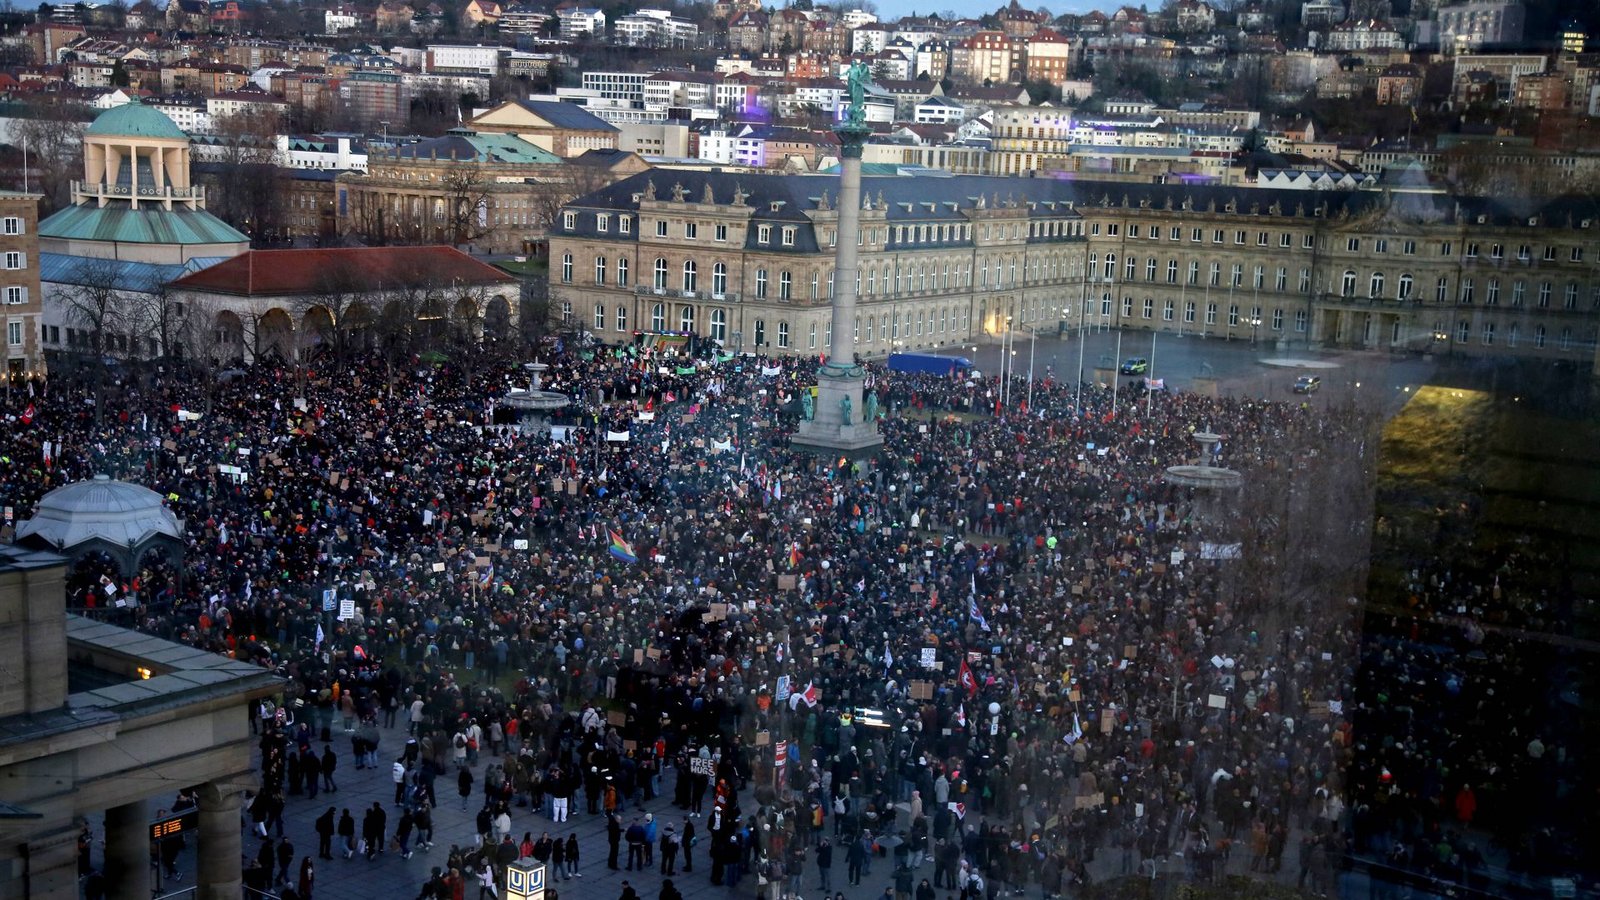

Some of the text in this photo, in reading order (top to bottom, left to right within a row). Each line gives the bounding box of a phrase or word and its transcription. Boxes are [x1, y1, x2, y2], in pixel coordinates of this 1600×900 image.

[690, 757, 714, 769] FREE
[690, 766, 716, 777] HUGS
[511, 871, 522, 887] U
[531, 870, 542, 887] U
